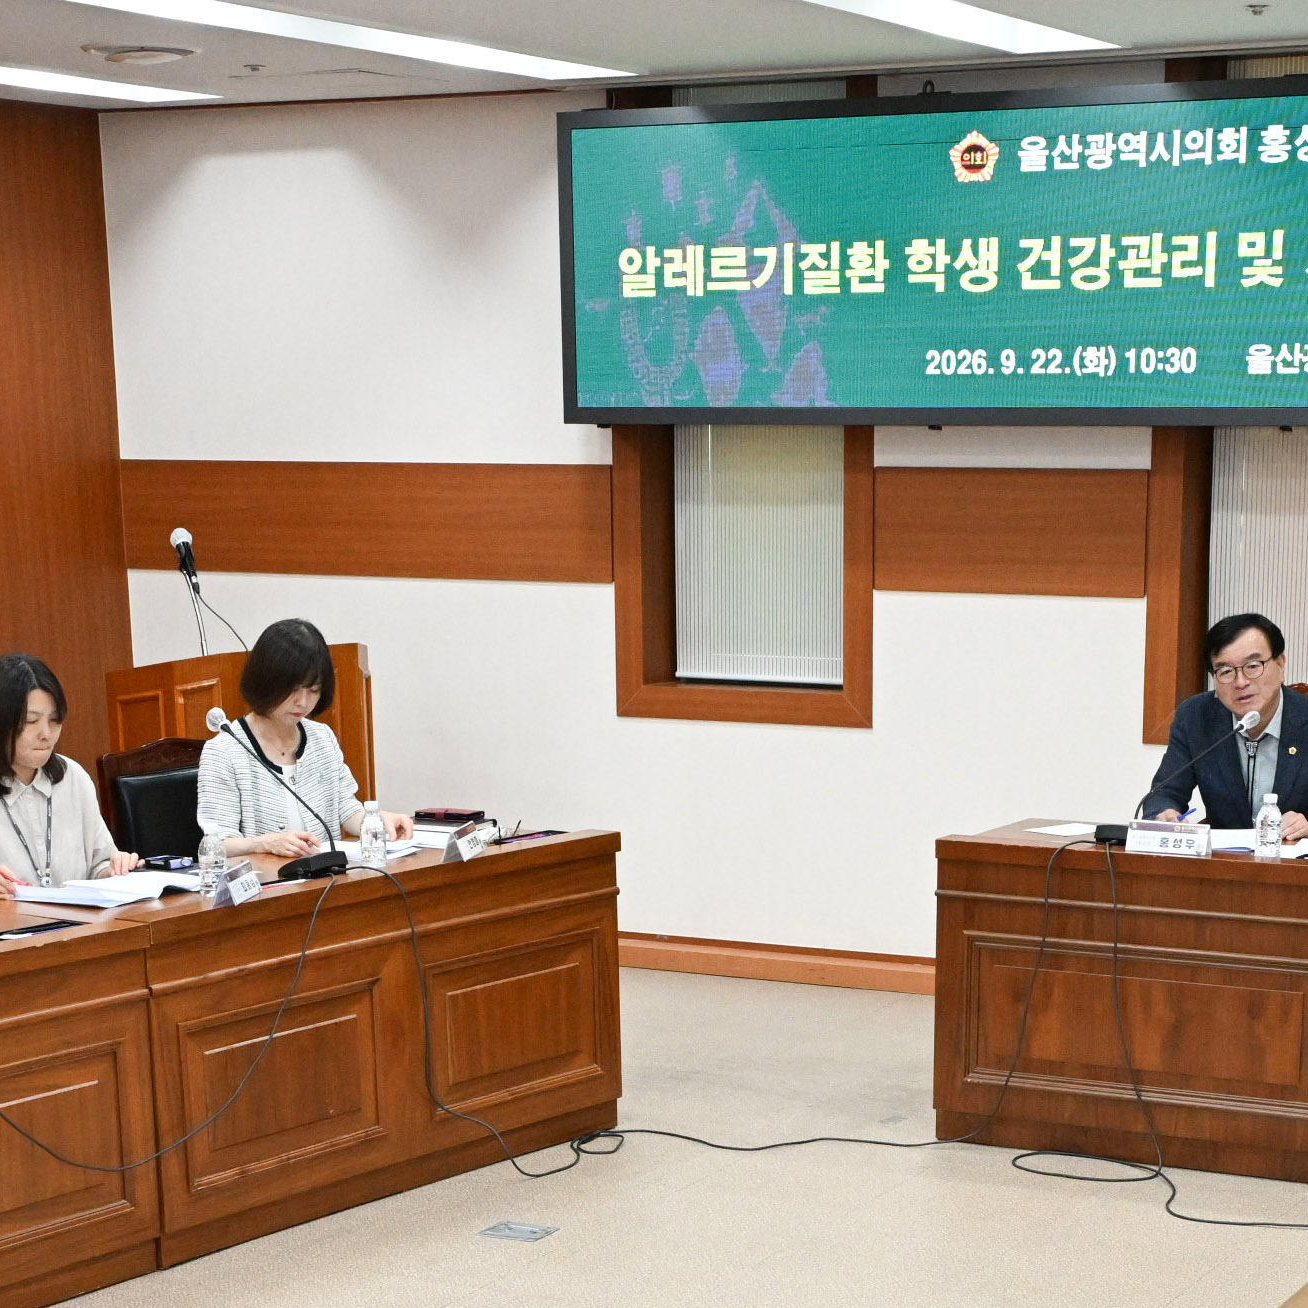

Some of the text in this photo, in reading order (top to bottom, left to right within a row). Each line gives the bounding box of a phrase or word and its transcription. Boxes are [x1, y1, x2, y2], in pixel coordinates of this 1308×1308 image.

[961, 150, 988, 165] 의회
[1017, 127, 1248, 172] 울산광역시의회
[618, 239, 890, 298] 알레르기질환
[904, 236, 999, 293] 학생
[1016, 230, 1218, 291] 건강관리
[1237, 229, 1285, 288] 및
[925, 348, 995, 375] 2026.
[1030, 345, 1117, 377] 22.(화)
[1124, 346, 1197, 374] 10:30
[1159, 837, 1195, 849] 홍성우
